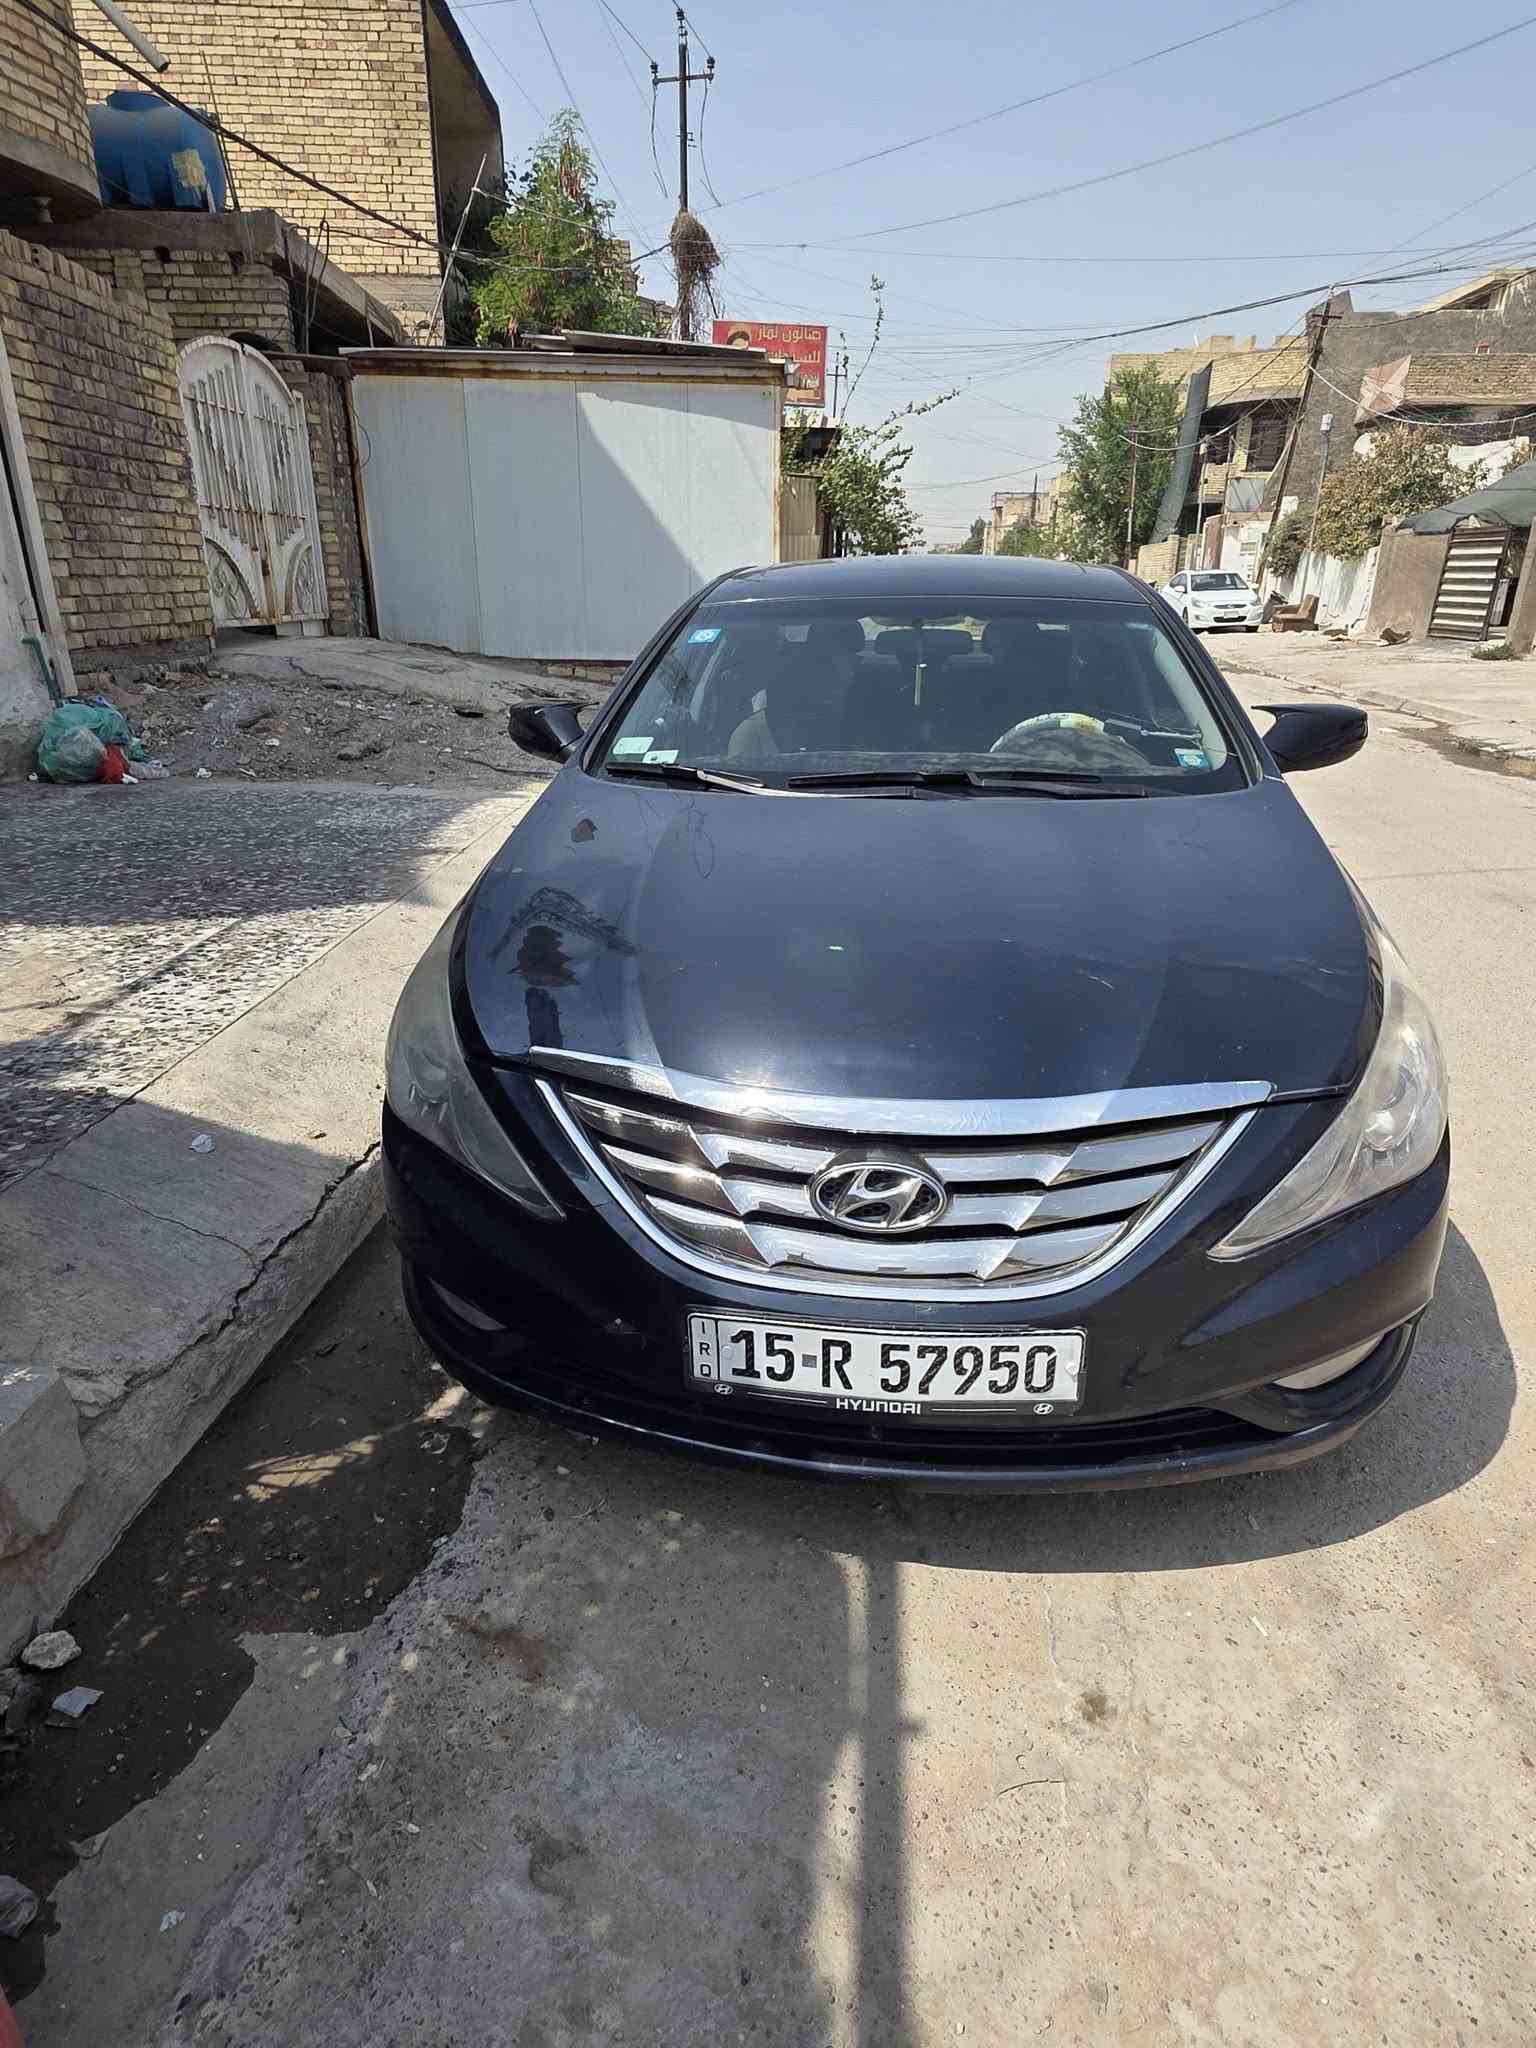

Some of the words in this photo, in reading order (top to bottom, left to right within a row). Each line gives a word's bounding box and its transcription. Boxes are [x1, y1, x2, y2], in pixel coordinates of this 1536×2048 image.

[783, 327, 821, 343] صالون
[699, 1320, 712, 1378] IRQ
[880, 1344, 1057, 1395] 57950
[836, 1398, 921, 1415] HYUNDAI
